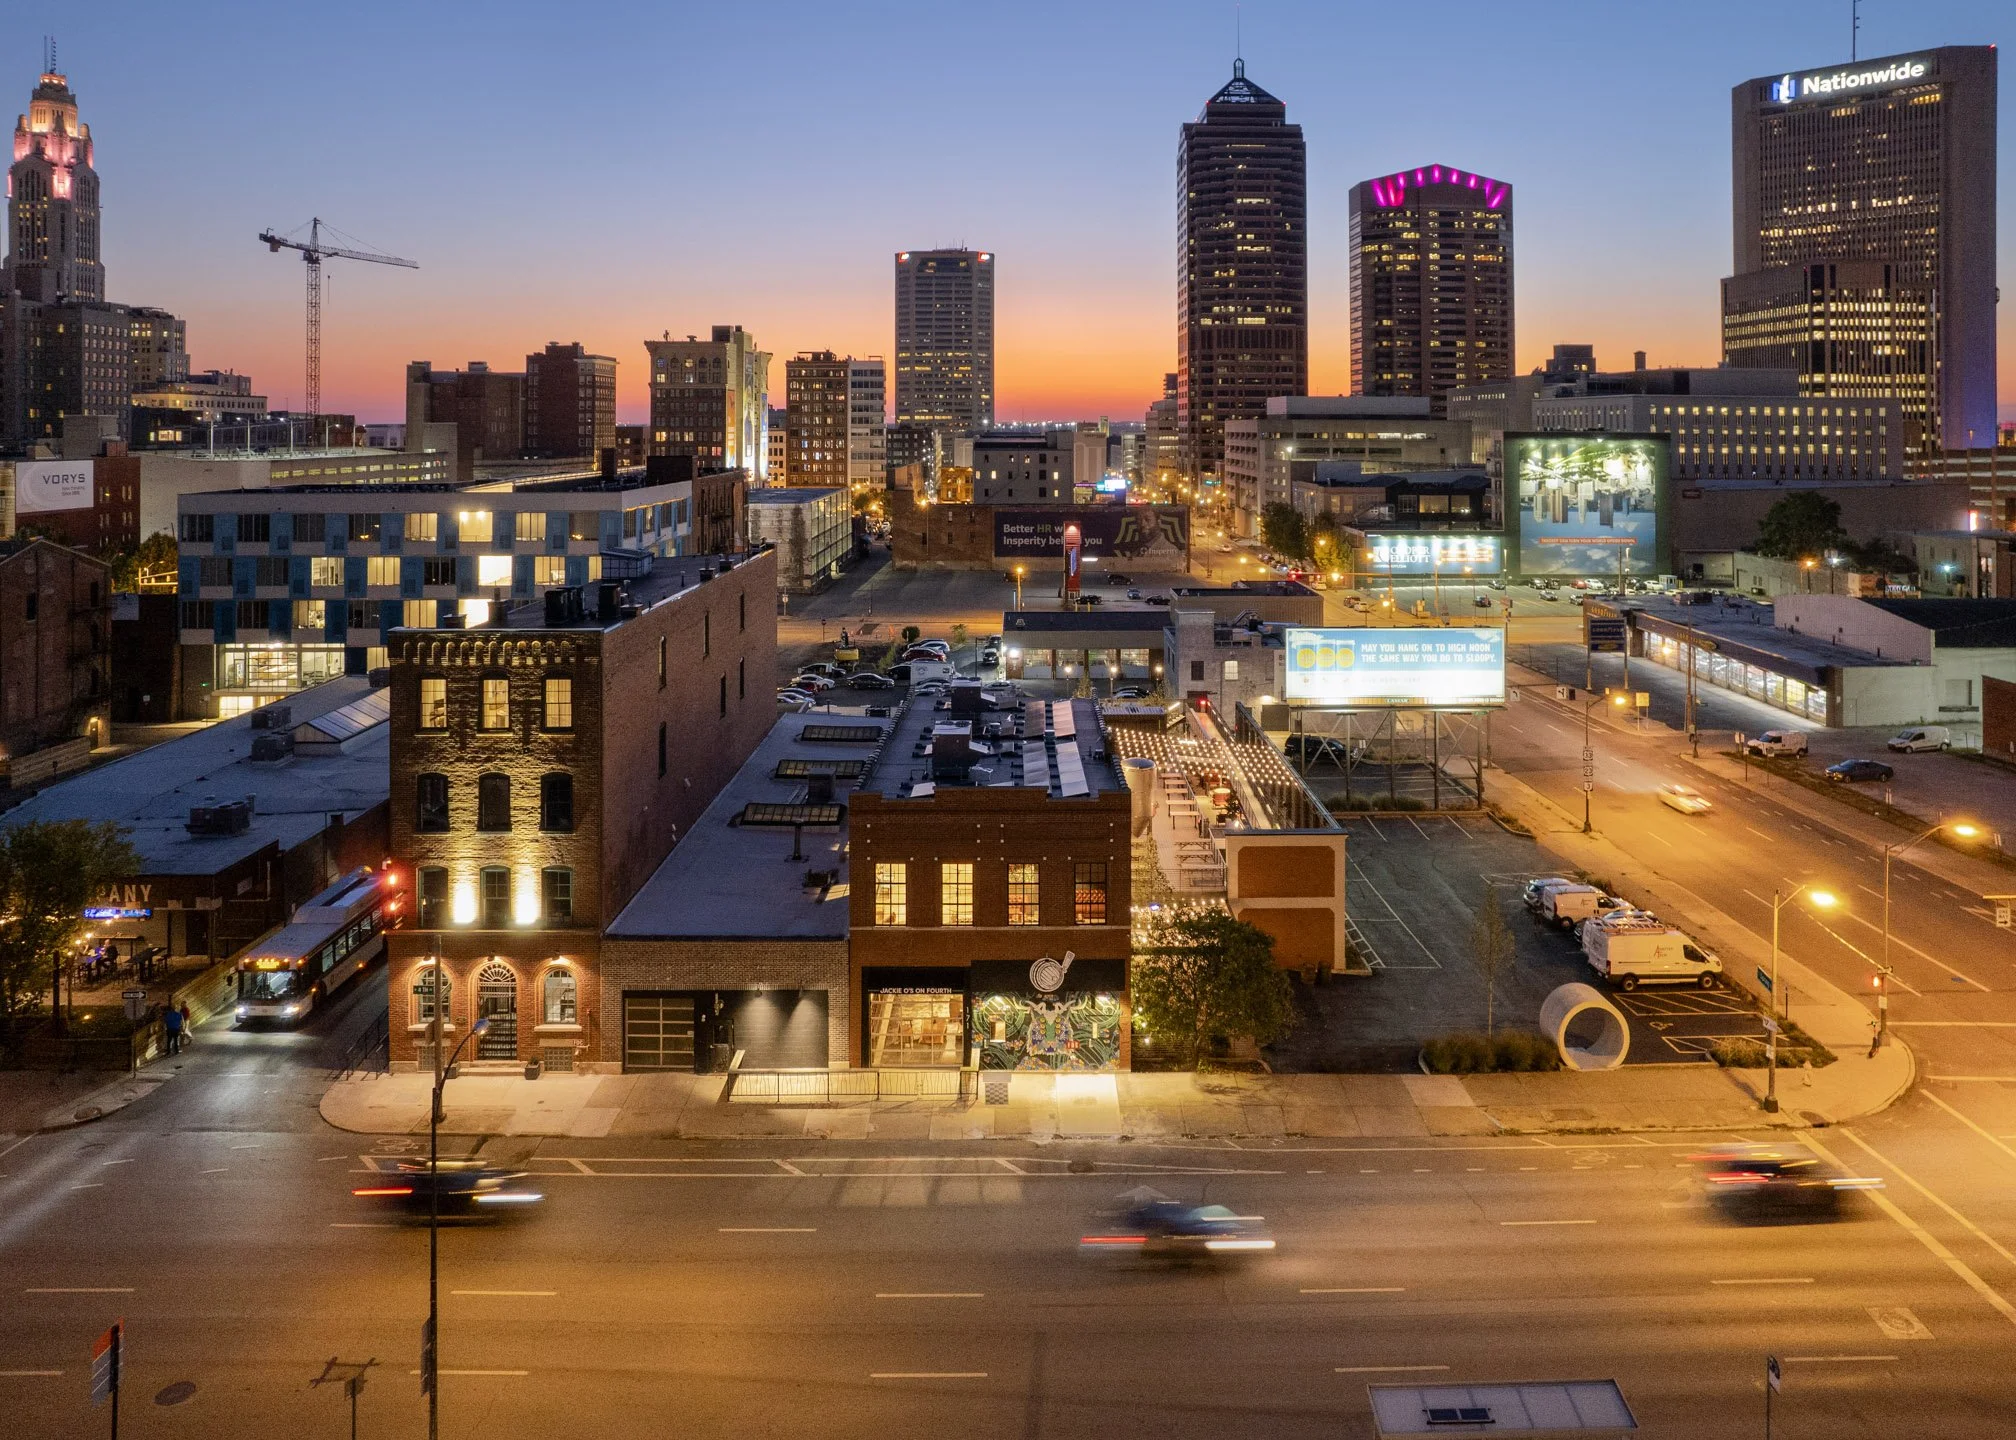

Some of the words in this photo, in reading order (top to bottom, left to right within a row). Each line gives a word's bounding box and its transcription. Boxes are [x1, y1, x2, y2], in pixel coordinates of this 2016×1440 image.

[1803, 62, 1925, 95] Nationwide
[42, 473, 86, 485] VORYS
[1003, 523, 1034, 533] Better
[1037, 524, 1052, 533] HR
[1003, 536, 1045, 548] Insperity
[1085, 537, 1103, 548] you
[1361, 643, 1378, 652] MAY
[1380, 643, 1395, 652] YOU
[1398, 643, 1419, 652] HANG
[1421, 643, 1433, 652] ON
[1435, 643, 1446, 652] TO
[1448, 643, 1467, 652] HIGH
[1469, 643, 1491, 652] NOON
[1361, 654, 1377, 663] THE
[1379, 654, 1400, 663] SAME
[1402, 654, 1420, 663] WAY
[1421, 654, 1438, 663] YOU
[1440, 654, 1451, 663] DO
[1453, 654, 1463, 663] TO
